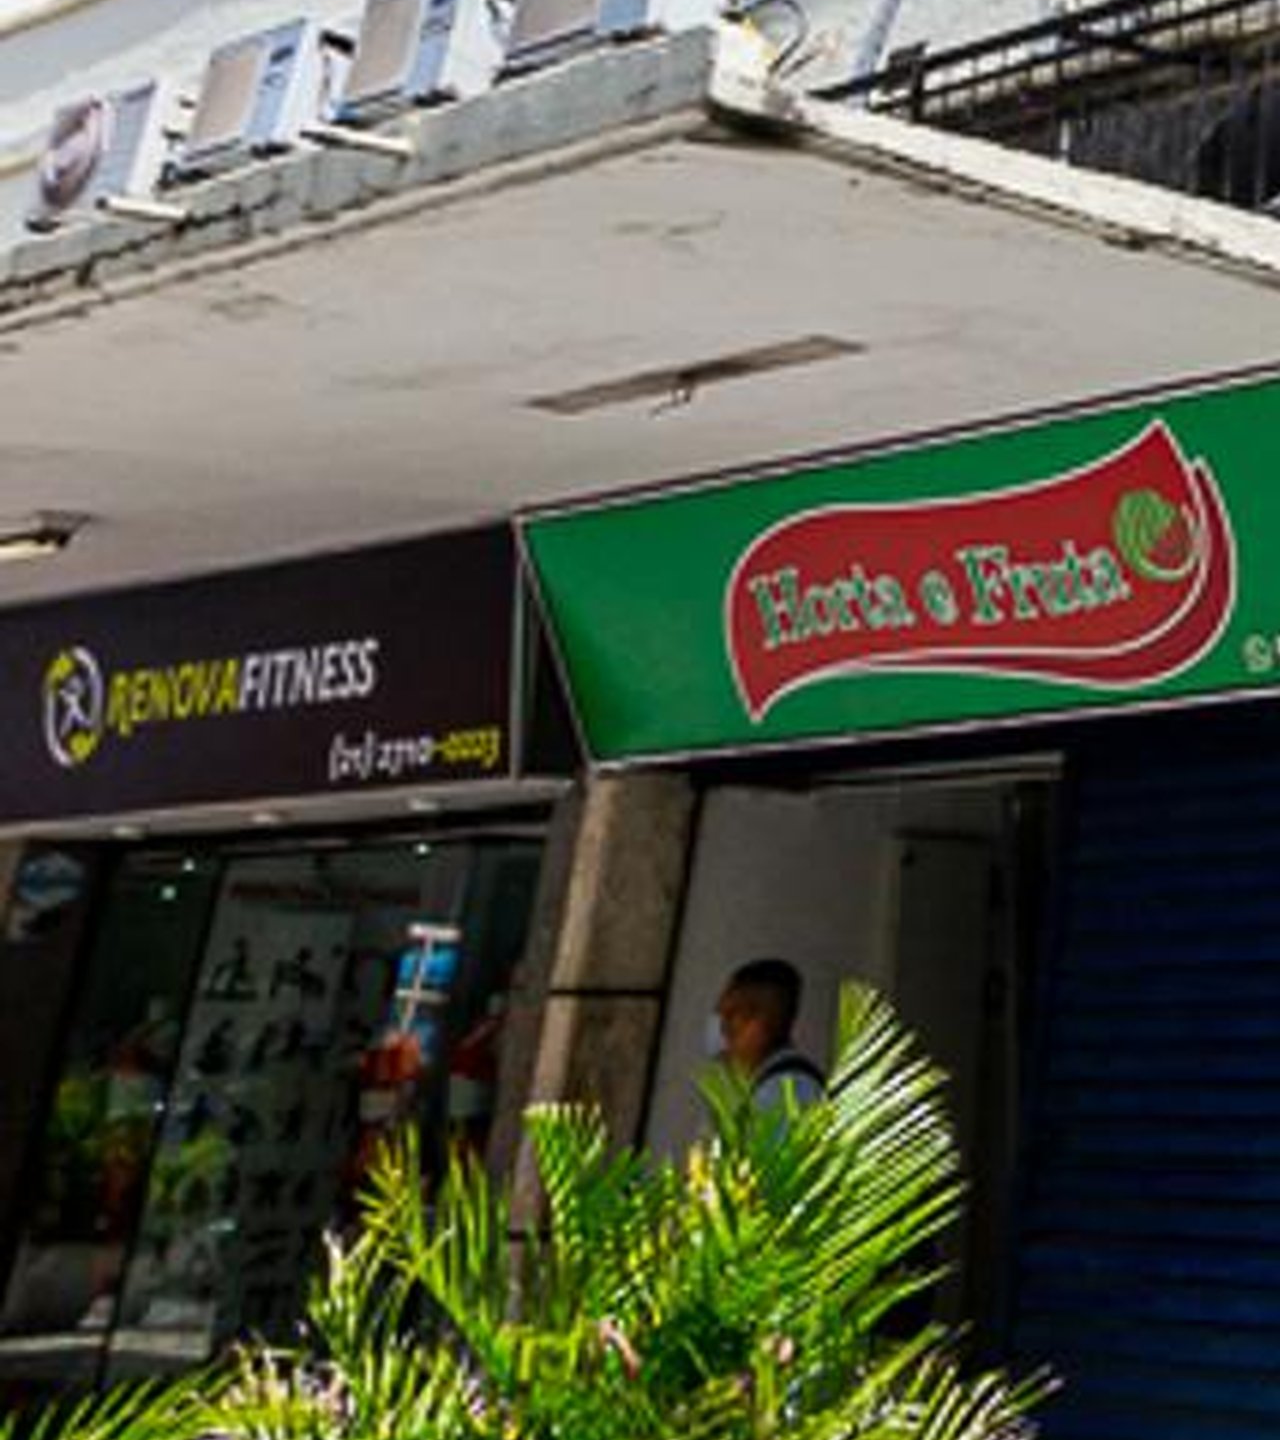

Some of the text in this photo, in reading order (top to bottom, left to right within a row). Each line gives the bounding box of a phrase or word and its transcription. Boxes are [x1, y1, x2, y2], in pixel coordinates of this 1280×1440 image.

[749, 538, 1133, 650] Horta e Fruta
